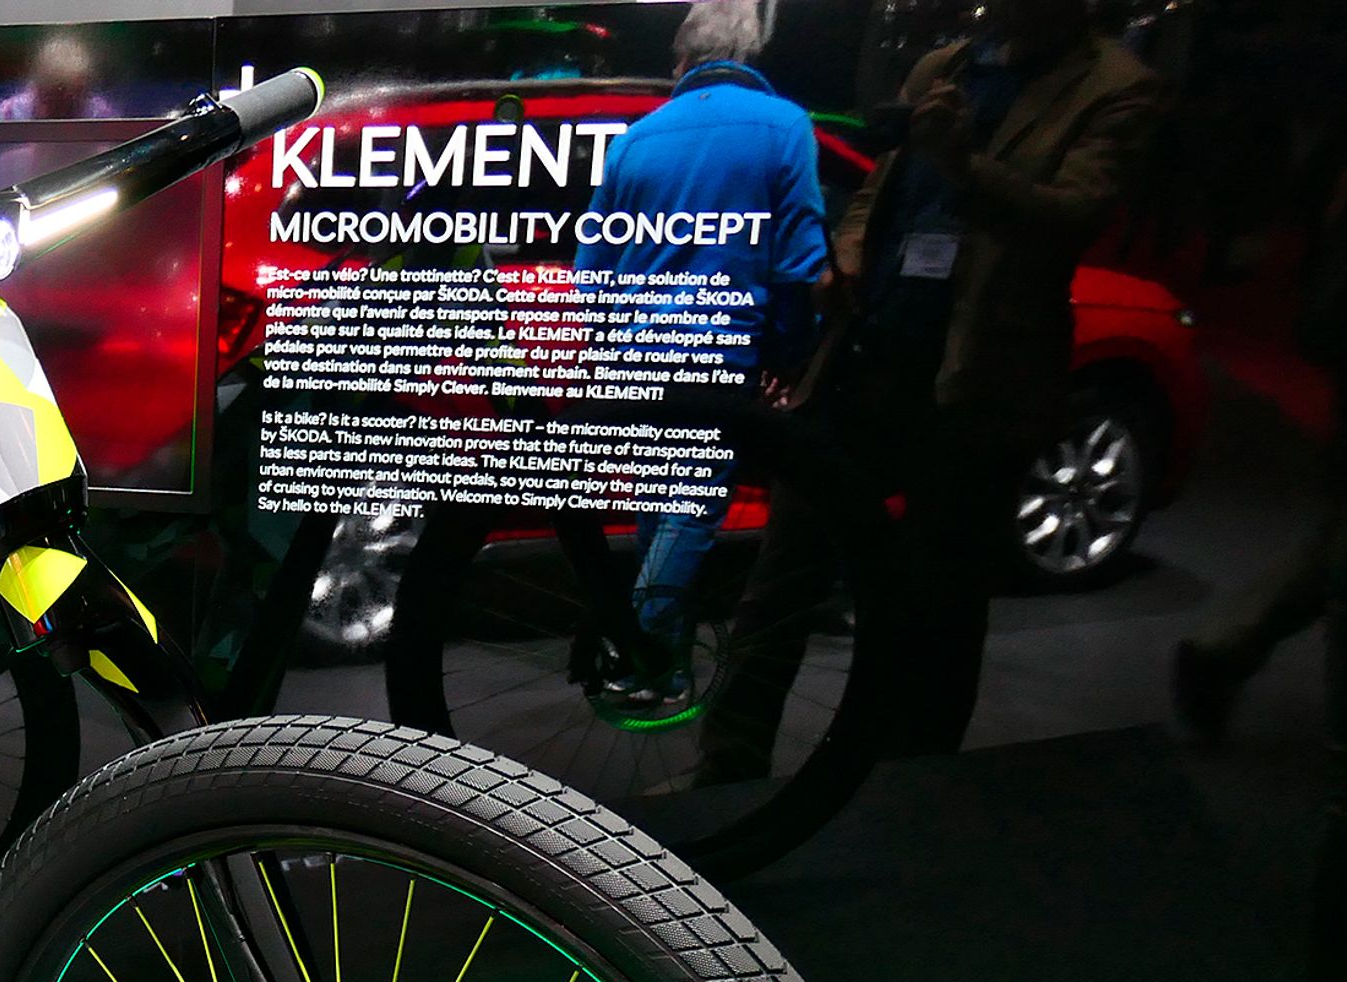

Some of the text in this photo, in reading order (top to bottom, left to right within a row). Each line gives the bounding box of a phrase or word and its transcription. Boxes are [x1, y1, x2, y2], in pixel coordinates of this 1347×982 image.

[270, 122, 628, 188] KLEMENT
[268, 211, 772, 245] MICROMOBILITY CONCEPT
[313, 271, 330, 281] un
[332, 268, 368, 281] vélo?
[370, 268, 398, 281] Une
[400, 269, 481, 282] trottinette?
[483, 269, 520, 283] C'est
[537, 270, 615, 287] KLEMENT,
[618, 274, 646, 285] une
[648, 271, 707, 285] solution
[710, 272, 730, 286] de
[267, 285, 754, 305] micro-mobilité conçue par ŠKODA. Cette dernière innovation de ŠKODA
[266, 303, 730, 325] démontre que l'avenir des transports repose moins sur nombre de
[266, 322, 750, 347] pièces que sur qualité des idées. Le KLEMENT été développé sans
[265, 340, 723, 364] pédales pour vous permettre de profiter du pur plaisir de rouler vers
[264, 359, 745, 384] votre destination dans un environnement urbain. Bienvenue dans l'ère
[263, 375, 664, 400] de micro-mobilité Simply Clever. Bienvenue au KLEMENT!
[294, 412, 721, 443] bike? scooter? It's the KLEMENT the micromobility concept
[261, 426, 733, 460] by ŠKODA. This new innovation proves that the future of transportation
[260, 445, 712, 477] has less parts and more great ideas. The KLEMENT developed for an
[260, 464, 727, 497] urban environment and without pedals, so you can enjoy the pure pleasure
[258, 497, 423, 518] Say hello to the KLEMENT.
[259, 480, 707, 517] of cruising to your destination. Welcome to Simply Clever micromobility.
